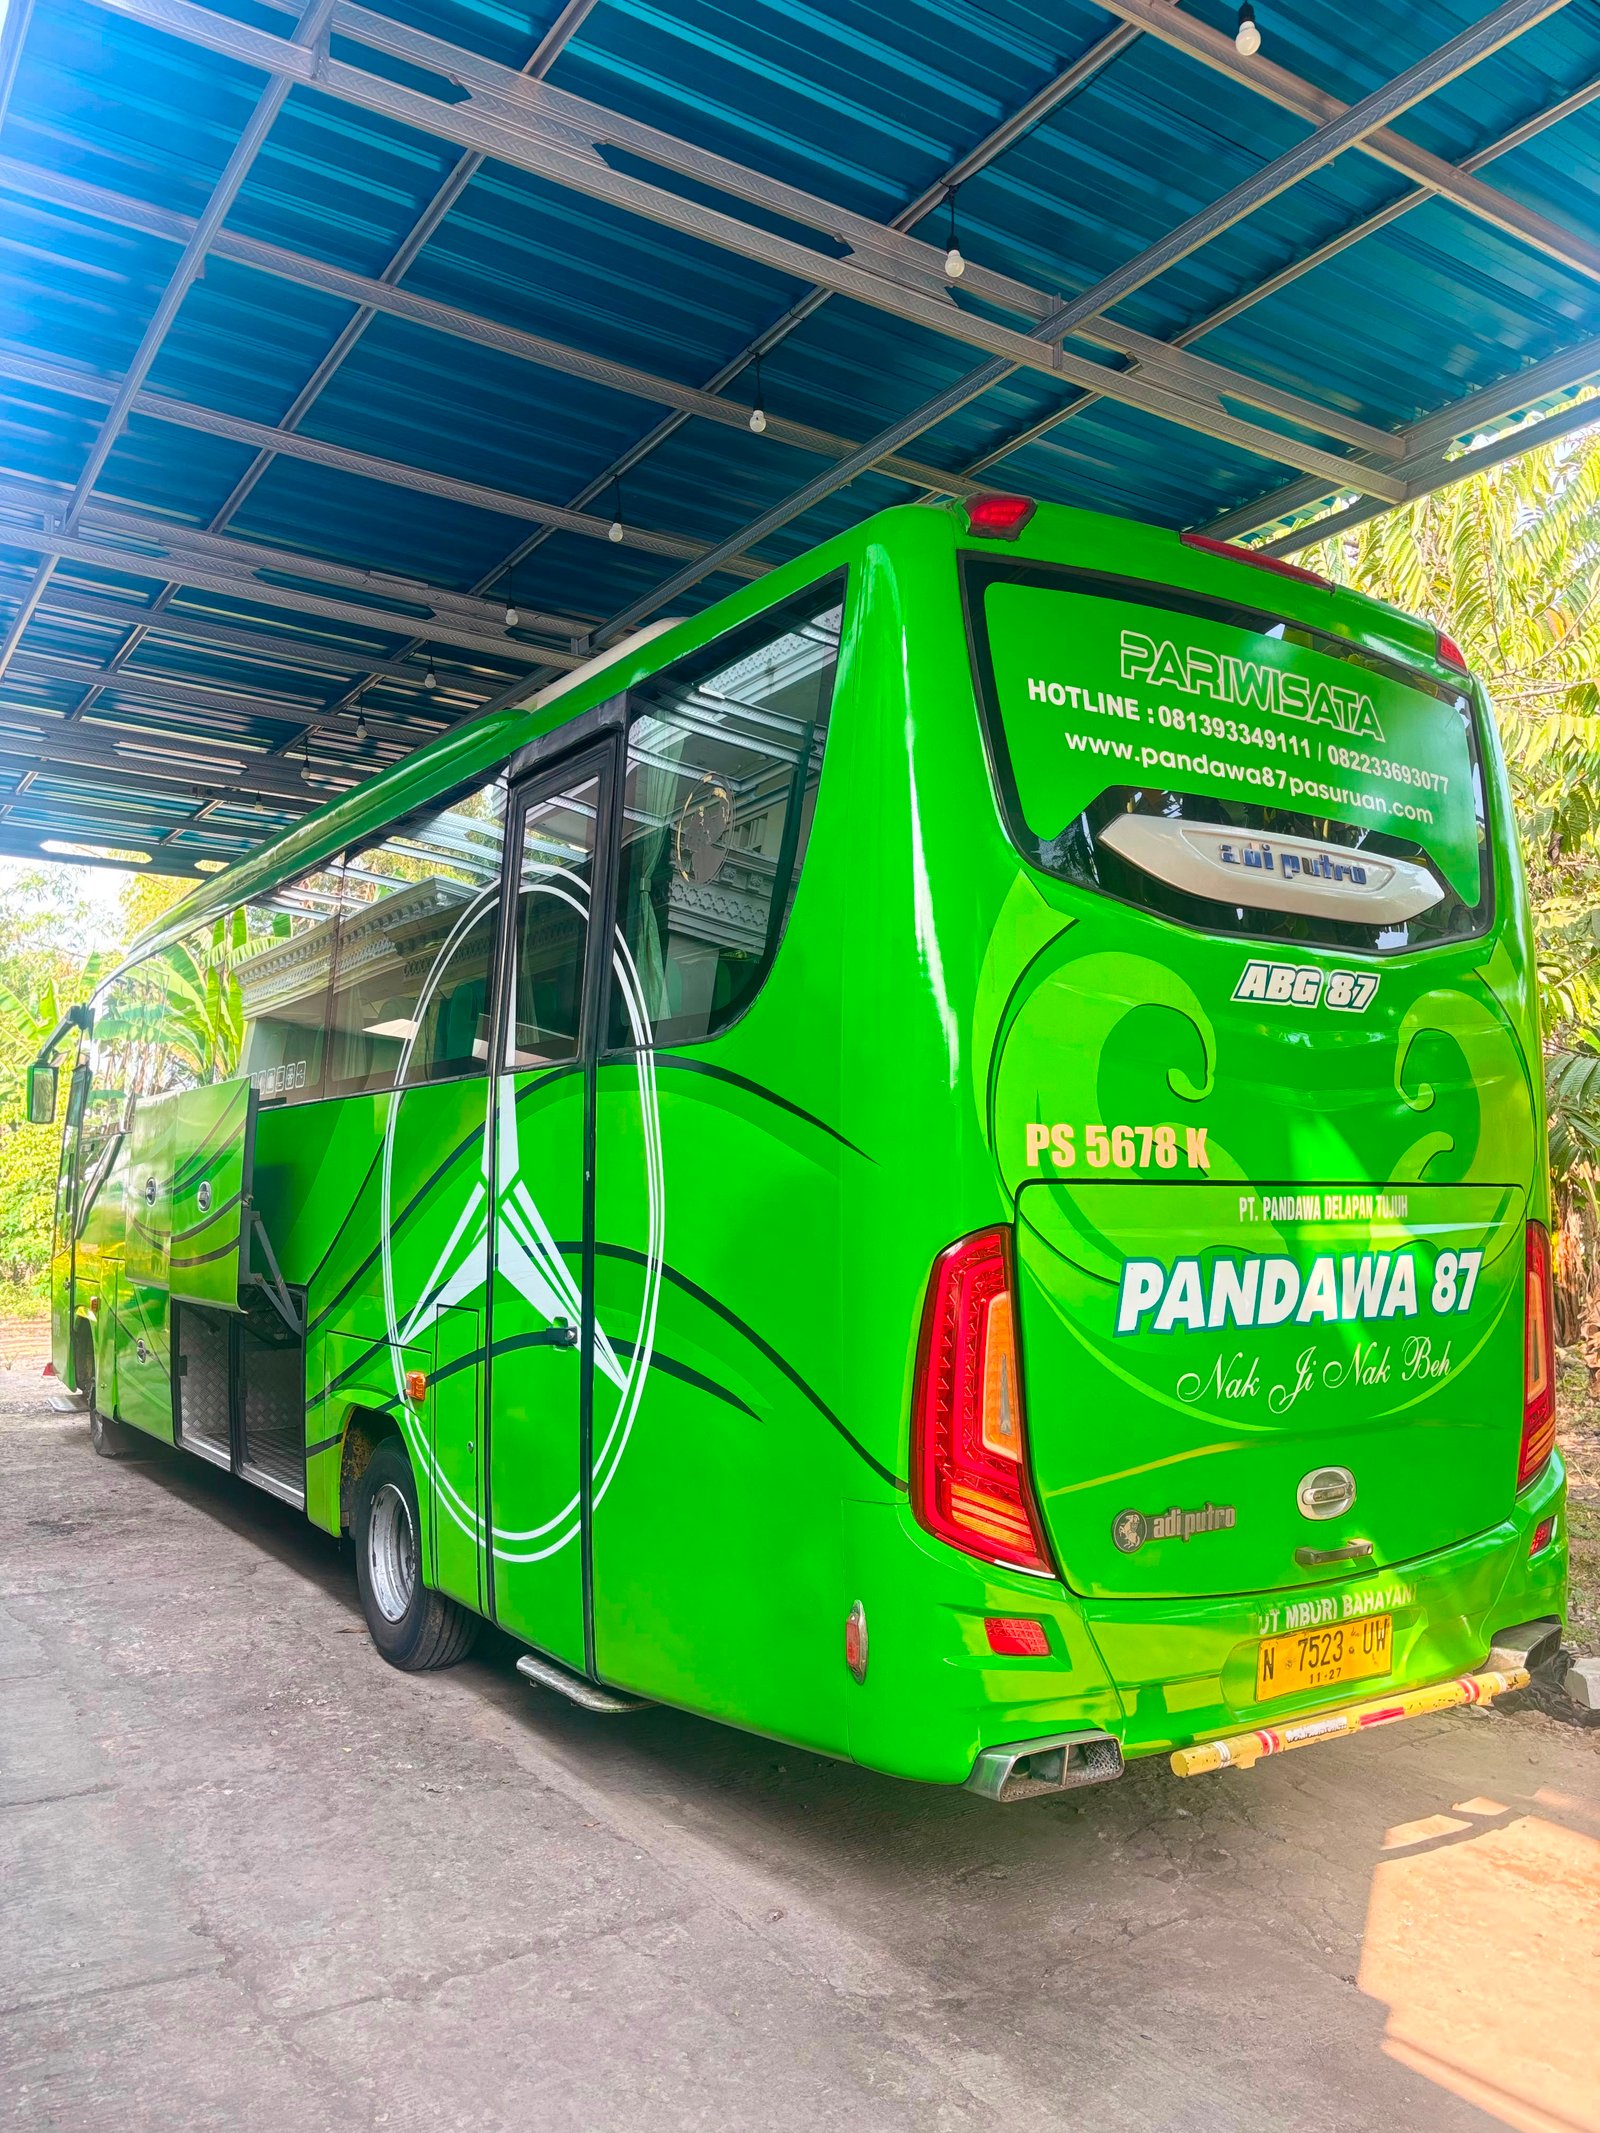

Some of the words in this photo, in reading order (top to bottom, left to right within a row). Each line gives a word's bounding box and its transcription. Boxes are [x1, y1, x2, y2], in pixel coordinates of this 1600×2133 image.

[1120, 629, 1386, 743] PARIWISATA
[1027, 677, 1141, 721] HOTLINE
[1327, 744, 1449, 795] 082233693077
[1064, 732, 1434, 825] www.pandawa87pasuruan.com
[1232, 961, 1323, 1007] ABG
[1325, 970, 1379, 1012] 87
[1026, 1123, 1076, 1168] PS
[1085, 1125, 1178, 1169] 5678
[1186, 1127, 1211, 1168] K
[1239, 1196, 1258, 1222] PT.
[1263, 1195, 1321, 1221] PANDAWA
[1324, 1194, 1373, 1220] DELAPAN
[1376, 1195, 1408, 1218] TUJUH
[1116, 1254, 1419, 1334] PANDAWA
[1431, 1249, 1484, 1314] 87
[1176, 1351, 1260, 1403] Nak
[1268, 1345, 1317, 1414] Ji
[1322, 1341, 1391, 1389] Nak
[1401, 1335, 1452, 1382] Beh
[1285, 1597, 1338, 1629] MBURI
[1263, 1647, 1275, 1682] N
[1298, 1630, 1344, 1671] 7523
[1363, 1618, 1388, 1654] UW
